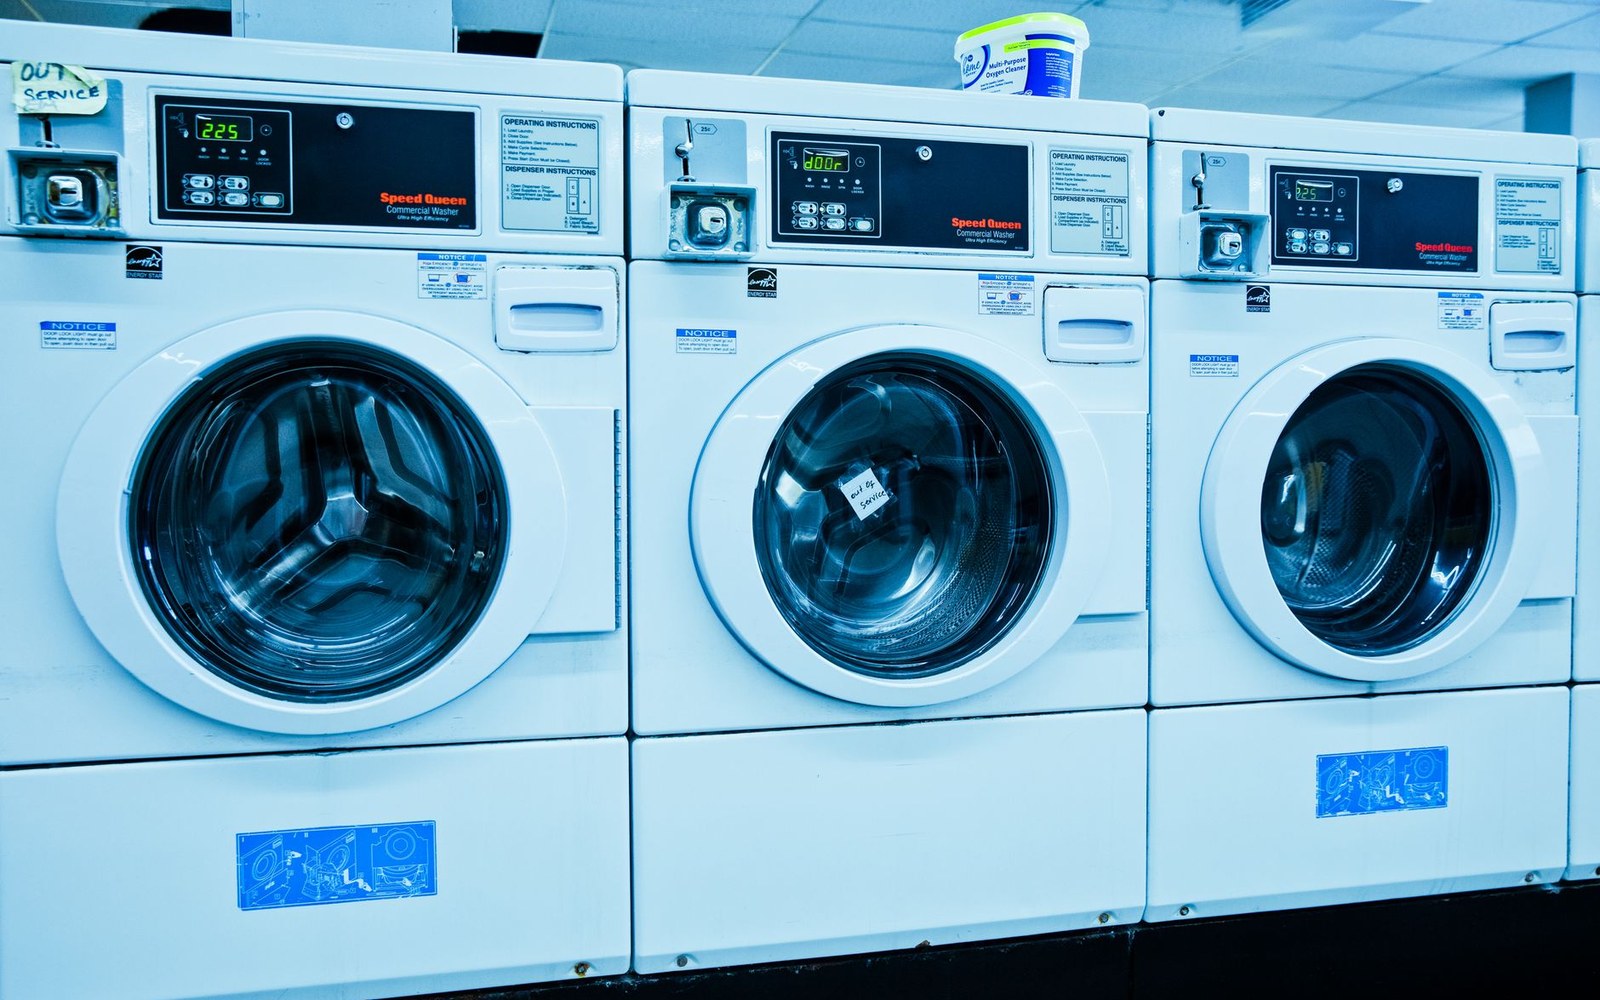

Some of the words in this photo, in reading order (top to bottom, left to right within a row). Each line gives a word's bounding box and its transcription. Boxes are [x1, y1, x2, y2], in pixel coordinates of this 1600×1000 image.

[990, 58, 1026, 69] Multi-Purpose
[21, 63, 64, 81] OUT
[986, 69, 1004, 78] Oxygen
[25, 86, 99, 100] SERVICE
[504, 118, 544, 126] OPERATING
[546, 120, 596, 129] INSTRUCTIONS
[202, 123, 238, 139] 225
[546, 167, 596, 176] INSTRUCTIONS
[380, 192, 422, 205] Speed
[425, 194, 467, 205] Queen
[386, 205, 430, 214] Commercial
[432, 207, 459, 215] Washer
[952, 217, 986, 228] Speed
[987, 218, 1022, 229] Queen
[956, 229, 992, 237] Commercial
[993, 230, 1015, 239] Washer
[1416, 242, 1444, 252] Speed
[1445, 243, 1472, 252] Queen
[851, 485, 863, 499] out
[866, 480, 875, 488] of
